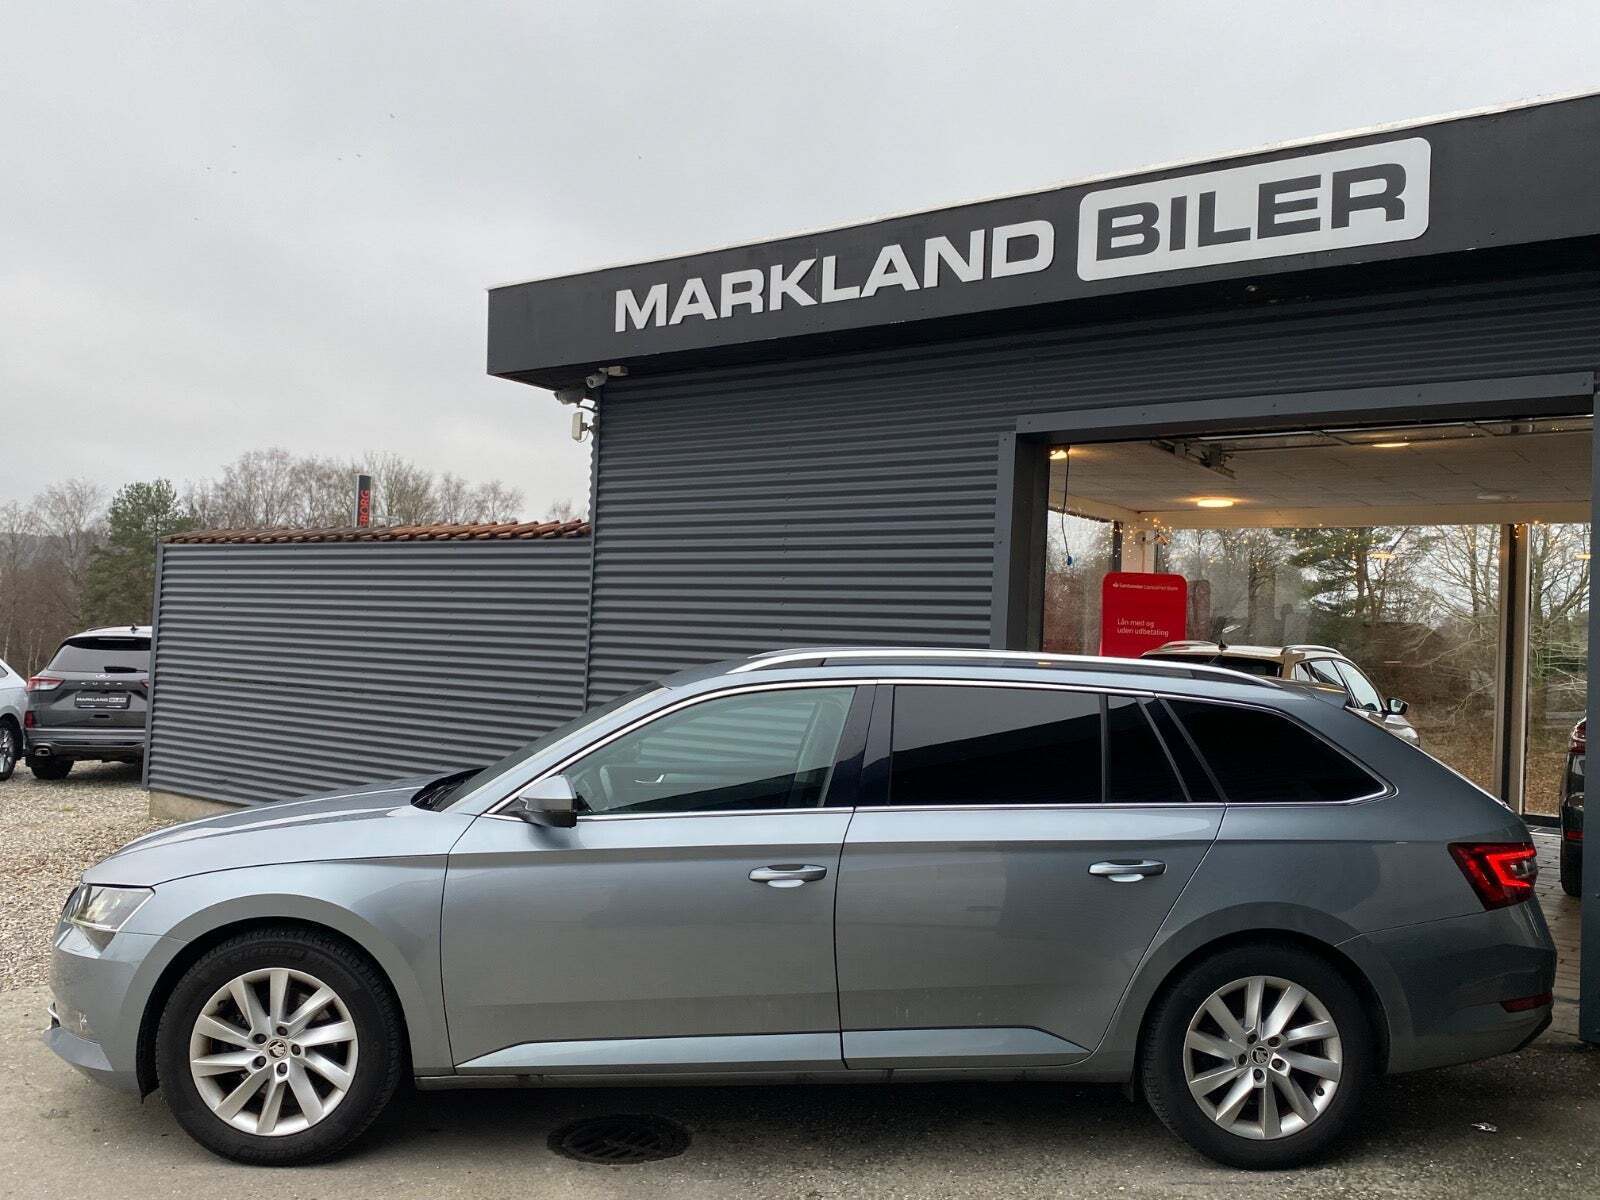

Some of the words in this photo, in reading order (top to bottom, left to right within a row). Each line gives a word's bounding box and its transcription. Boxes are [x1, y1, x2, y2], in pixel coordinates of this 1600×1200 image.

[615, 219, 1054, 333] MARKLAND
[1096, 163, 1407, 261] BILER
[1117, 626, 1134, 634] uden
[1135, 628, 1169, 637] udbetaling
